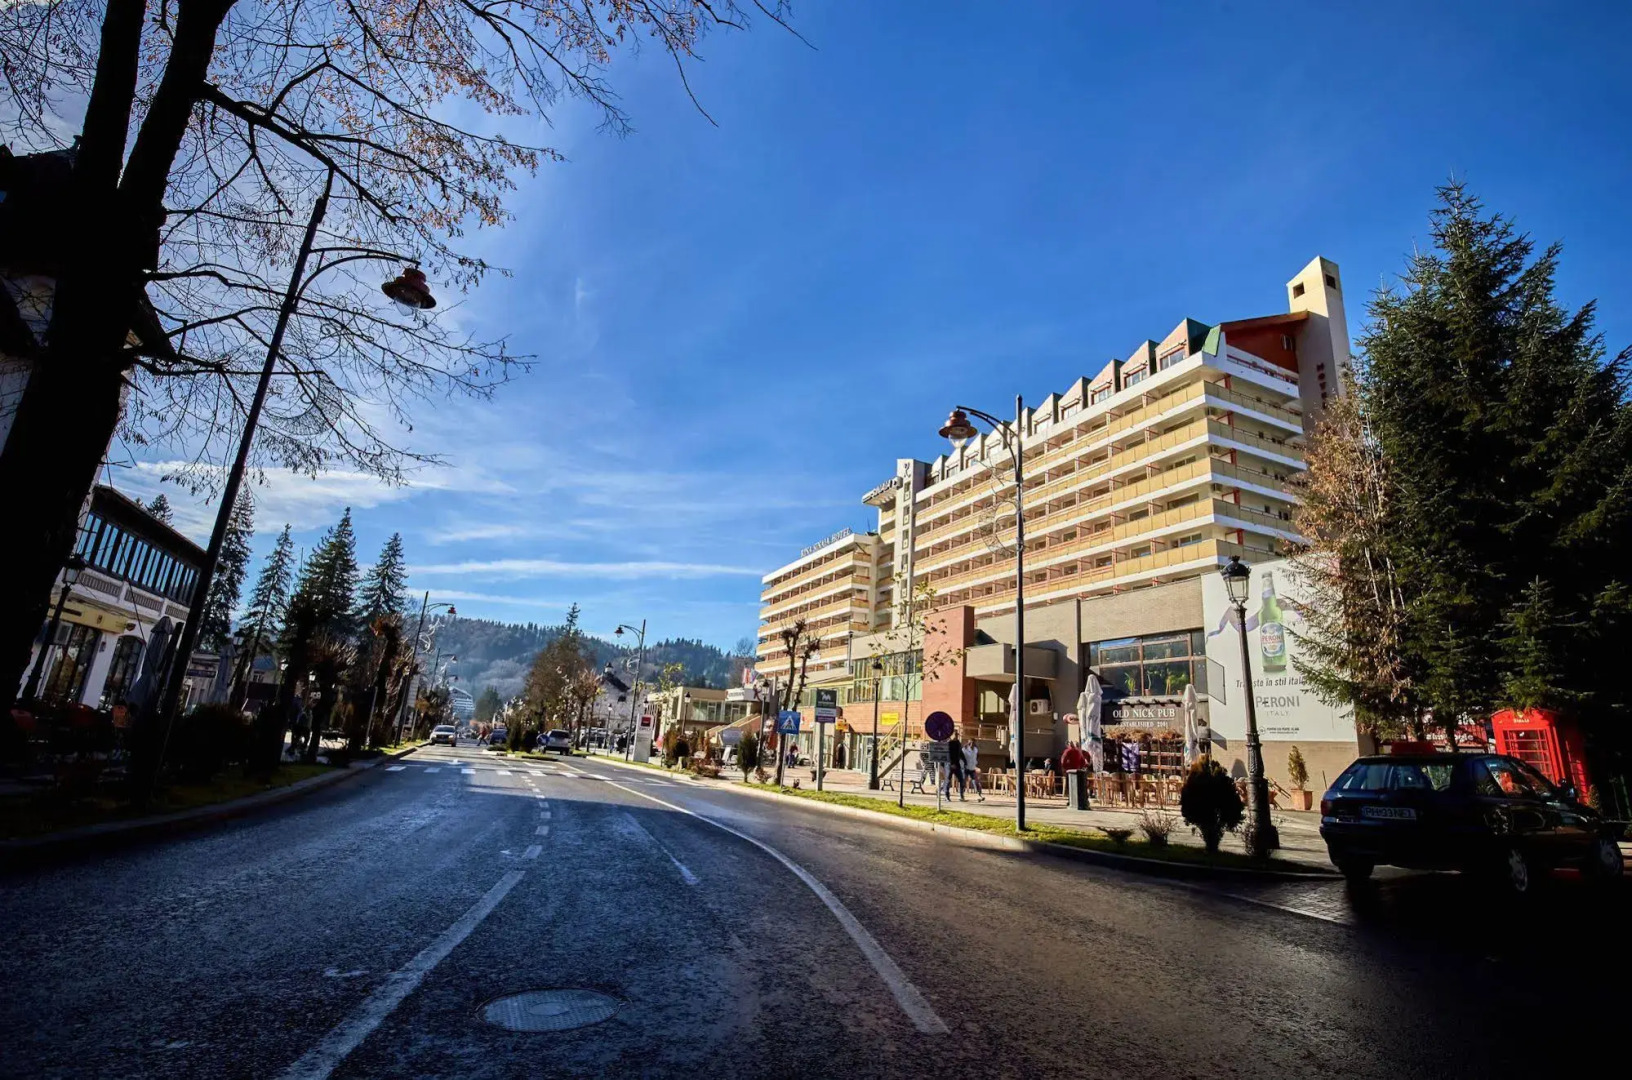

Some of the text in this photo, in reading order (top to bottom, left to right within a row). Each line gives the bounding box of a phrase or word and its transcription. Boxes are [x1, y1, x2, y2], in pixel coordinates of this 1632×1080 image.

[1274, 677, 1287, 686] stil
[1255, 695, 1300, 708] PERONI
[1112, 708, 1175, 718] OLD NICK PUB
